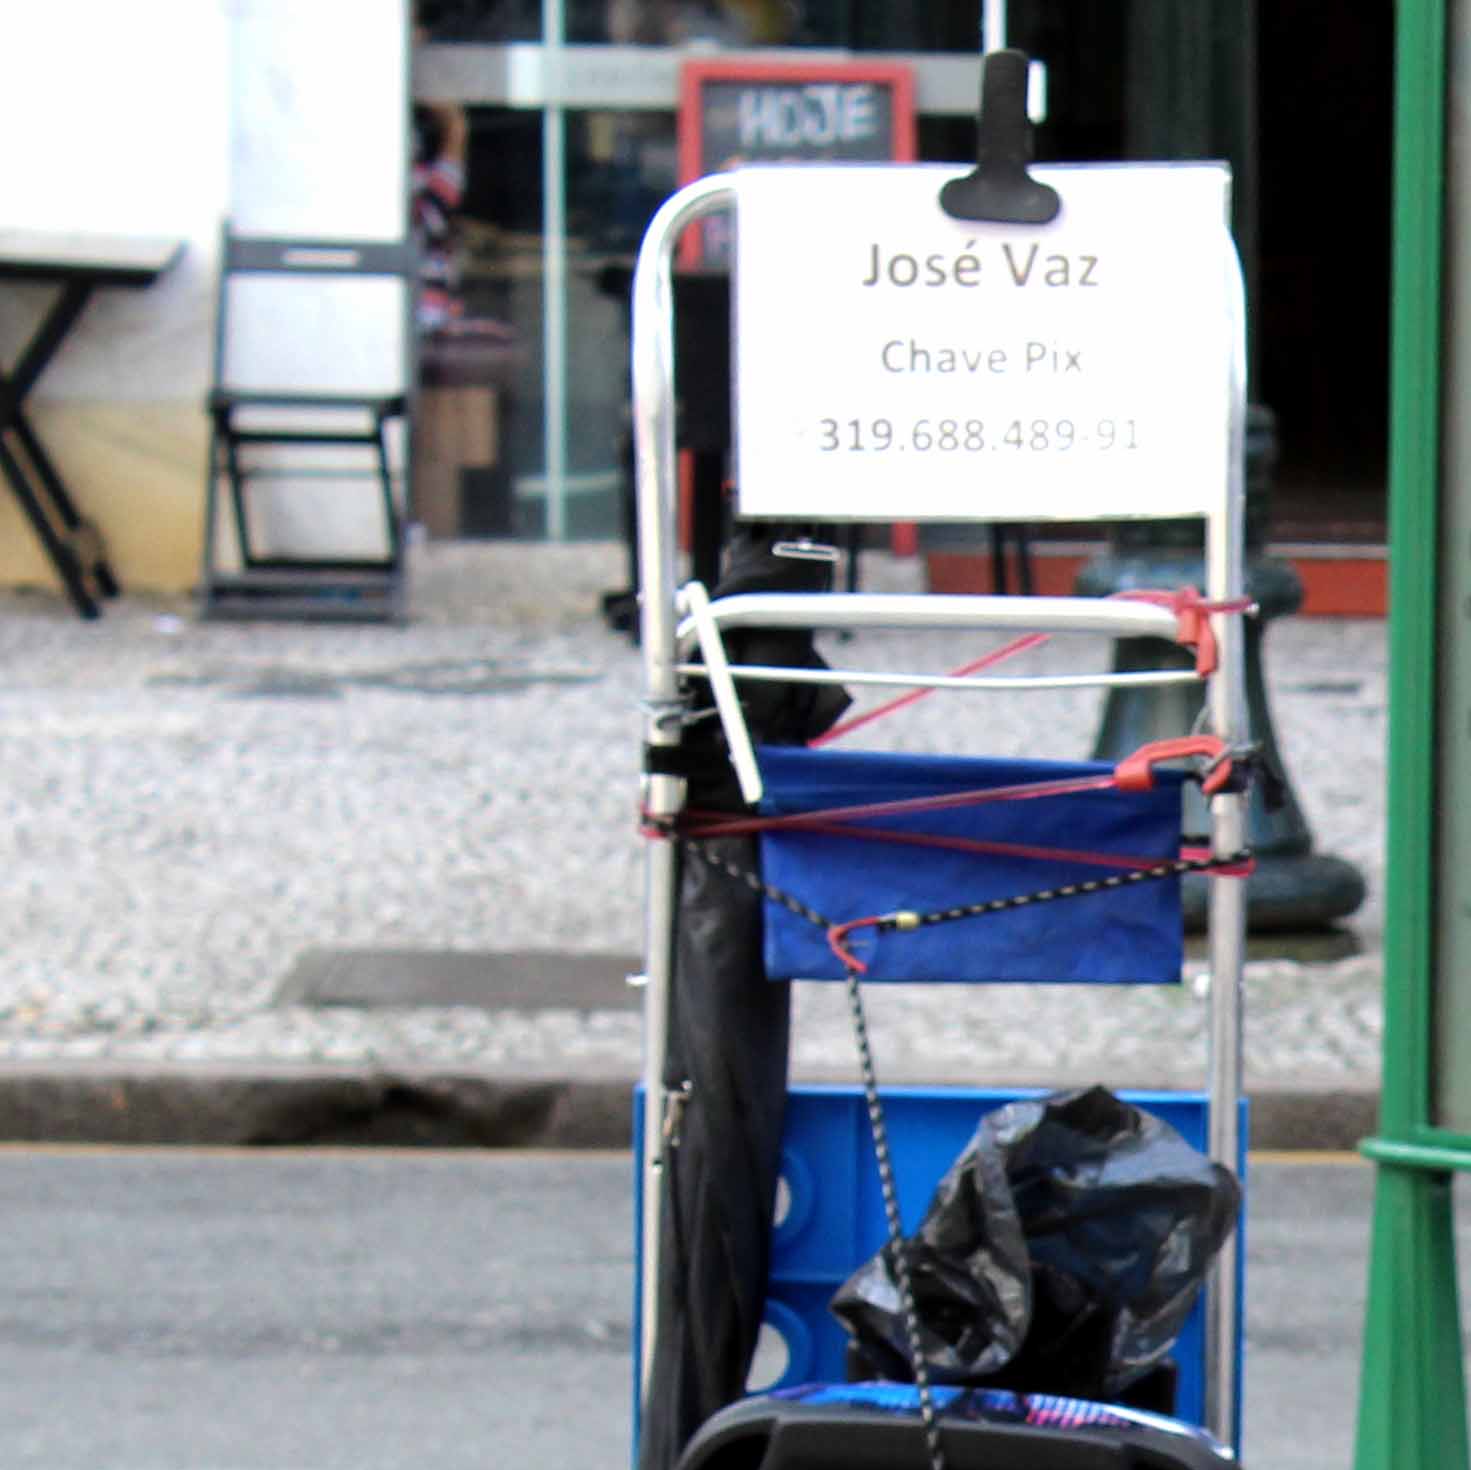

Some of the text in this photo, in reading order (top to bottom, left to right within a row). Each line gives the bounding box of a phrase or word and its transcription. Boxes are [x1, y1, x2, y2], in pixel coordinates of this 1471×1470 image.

[738, 84, 880, 147] HOJE
[863, 238, 1099, 287] José Vaz
[882, 338, 1083, 374] Chave Pix
[819, 417, 1140, 452] 319.688.489-91
